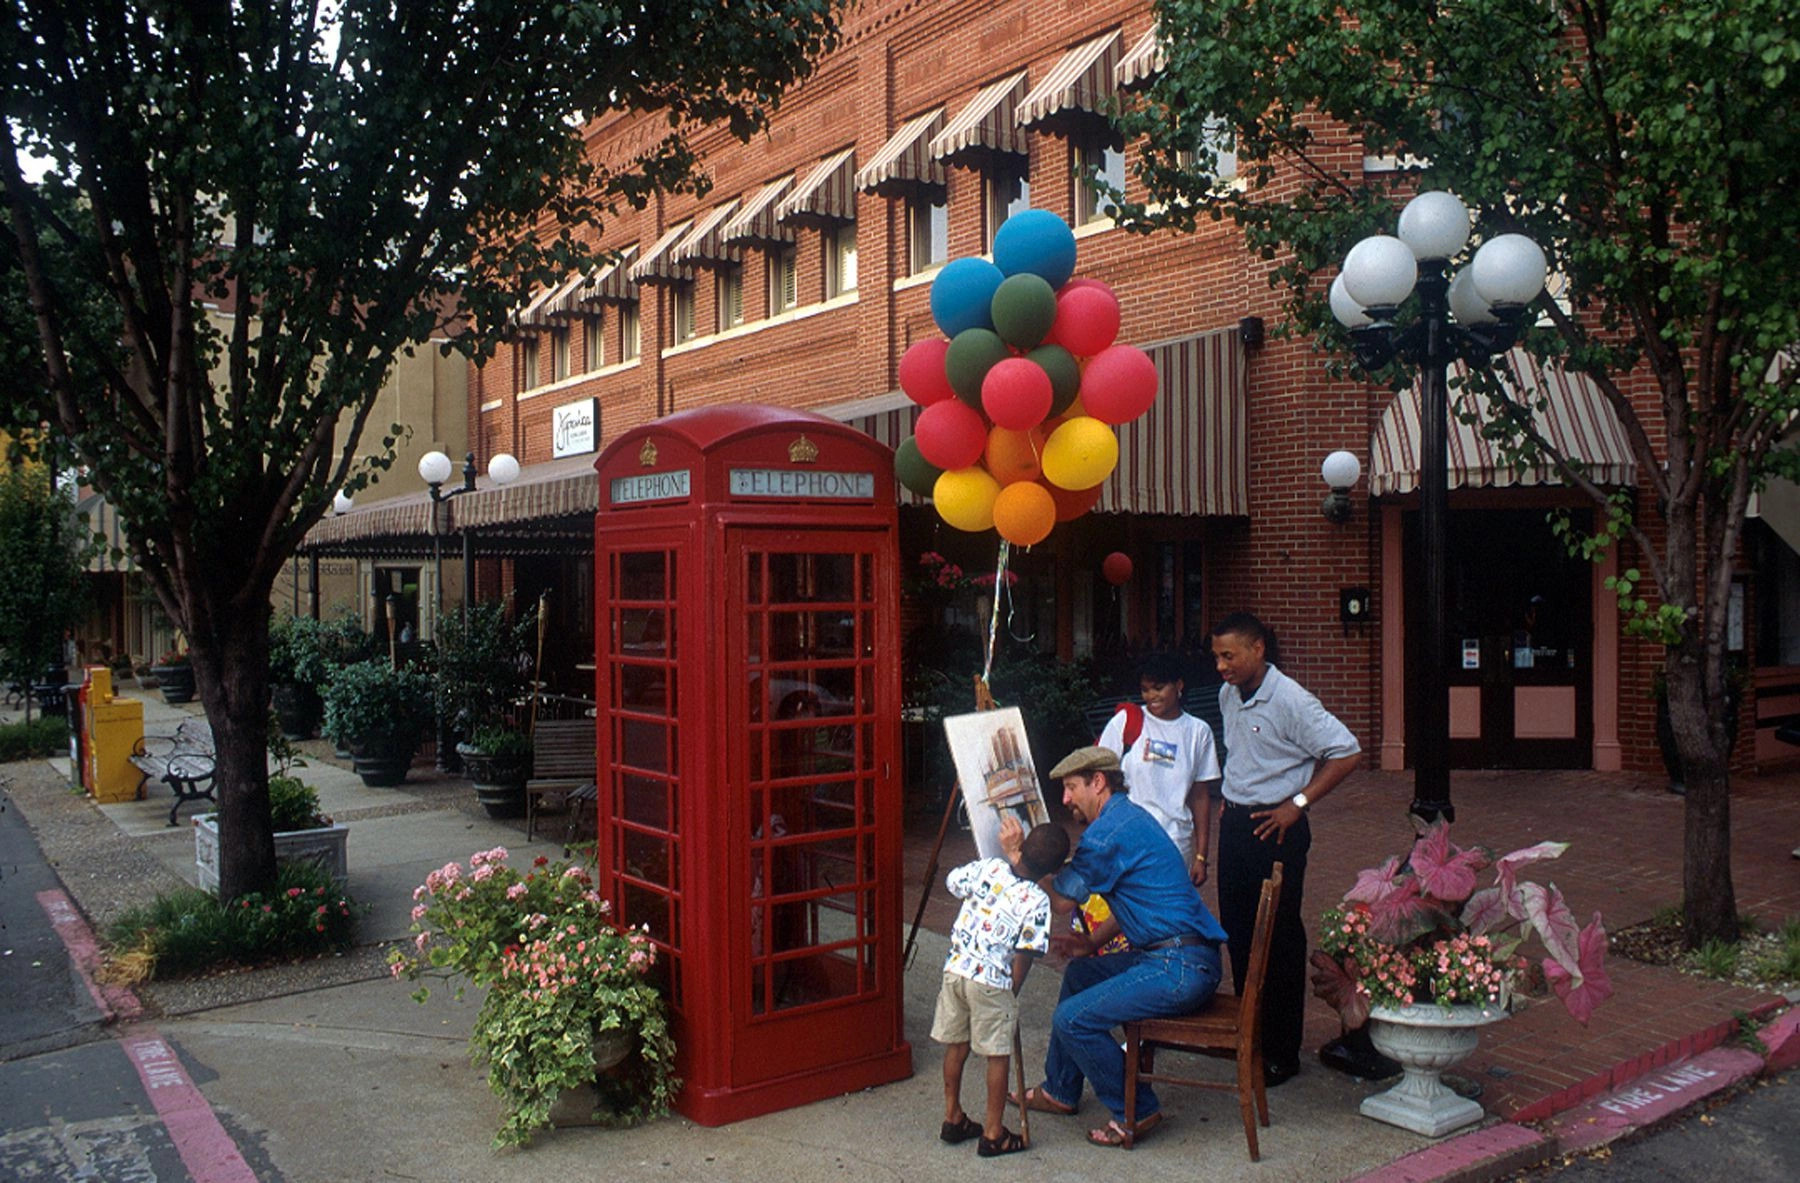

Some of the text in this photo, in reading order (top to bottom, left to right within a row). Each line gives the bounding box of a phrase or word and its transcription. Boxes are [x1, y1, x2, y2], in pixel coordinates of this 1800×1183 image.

[612, 473, 688, 501] TELEPHONE
[735, 472, 868, 495] TELEPHONE
[1599, 1065, 1717, 1115] FIRE LANE
